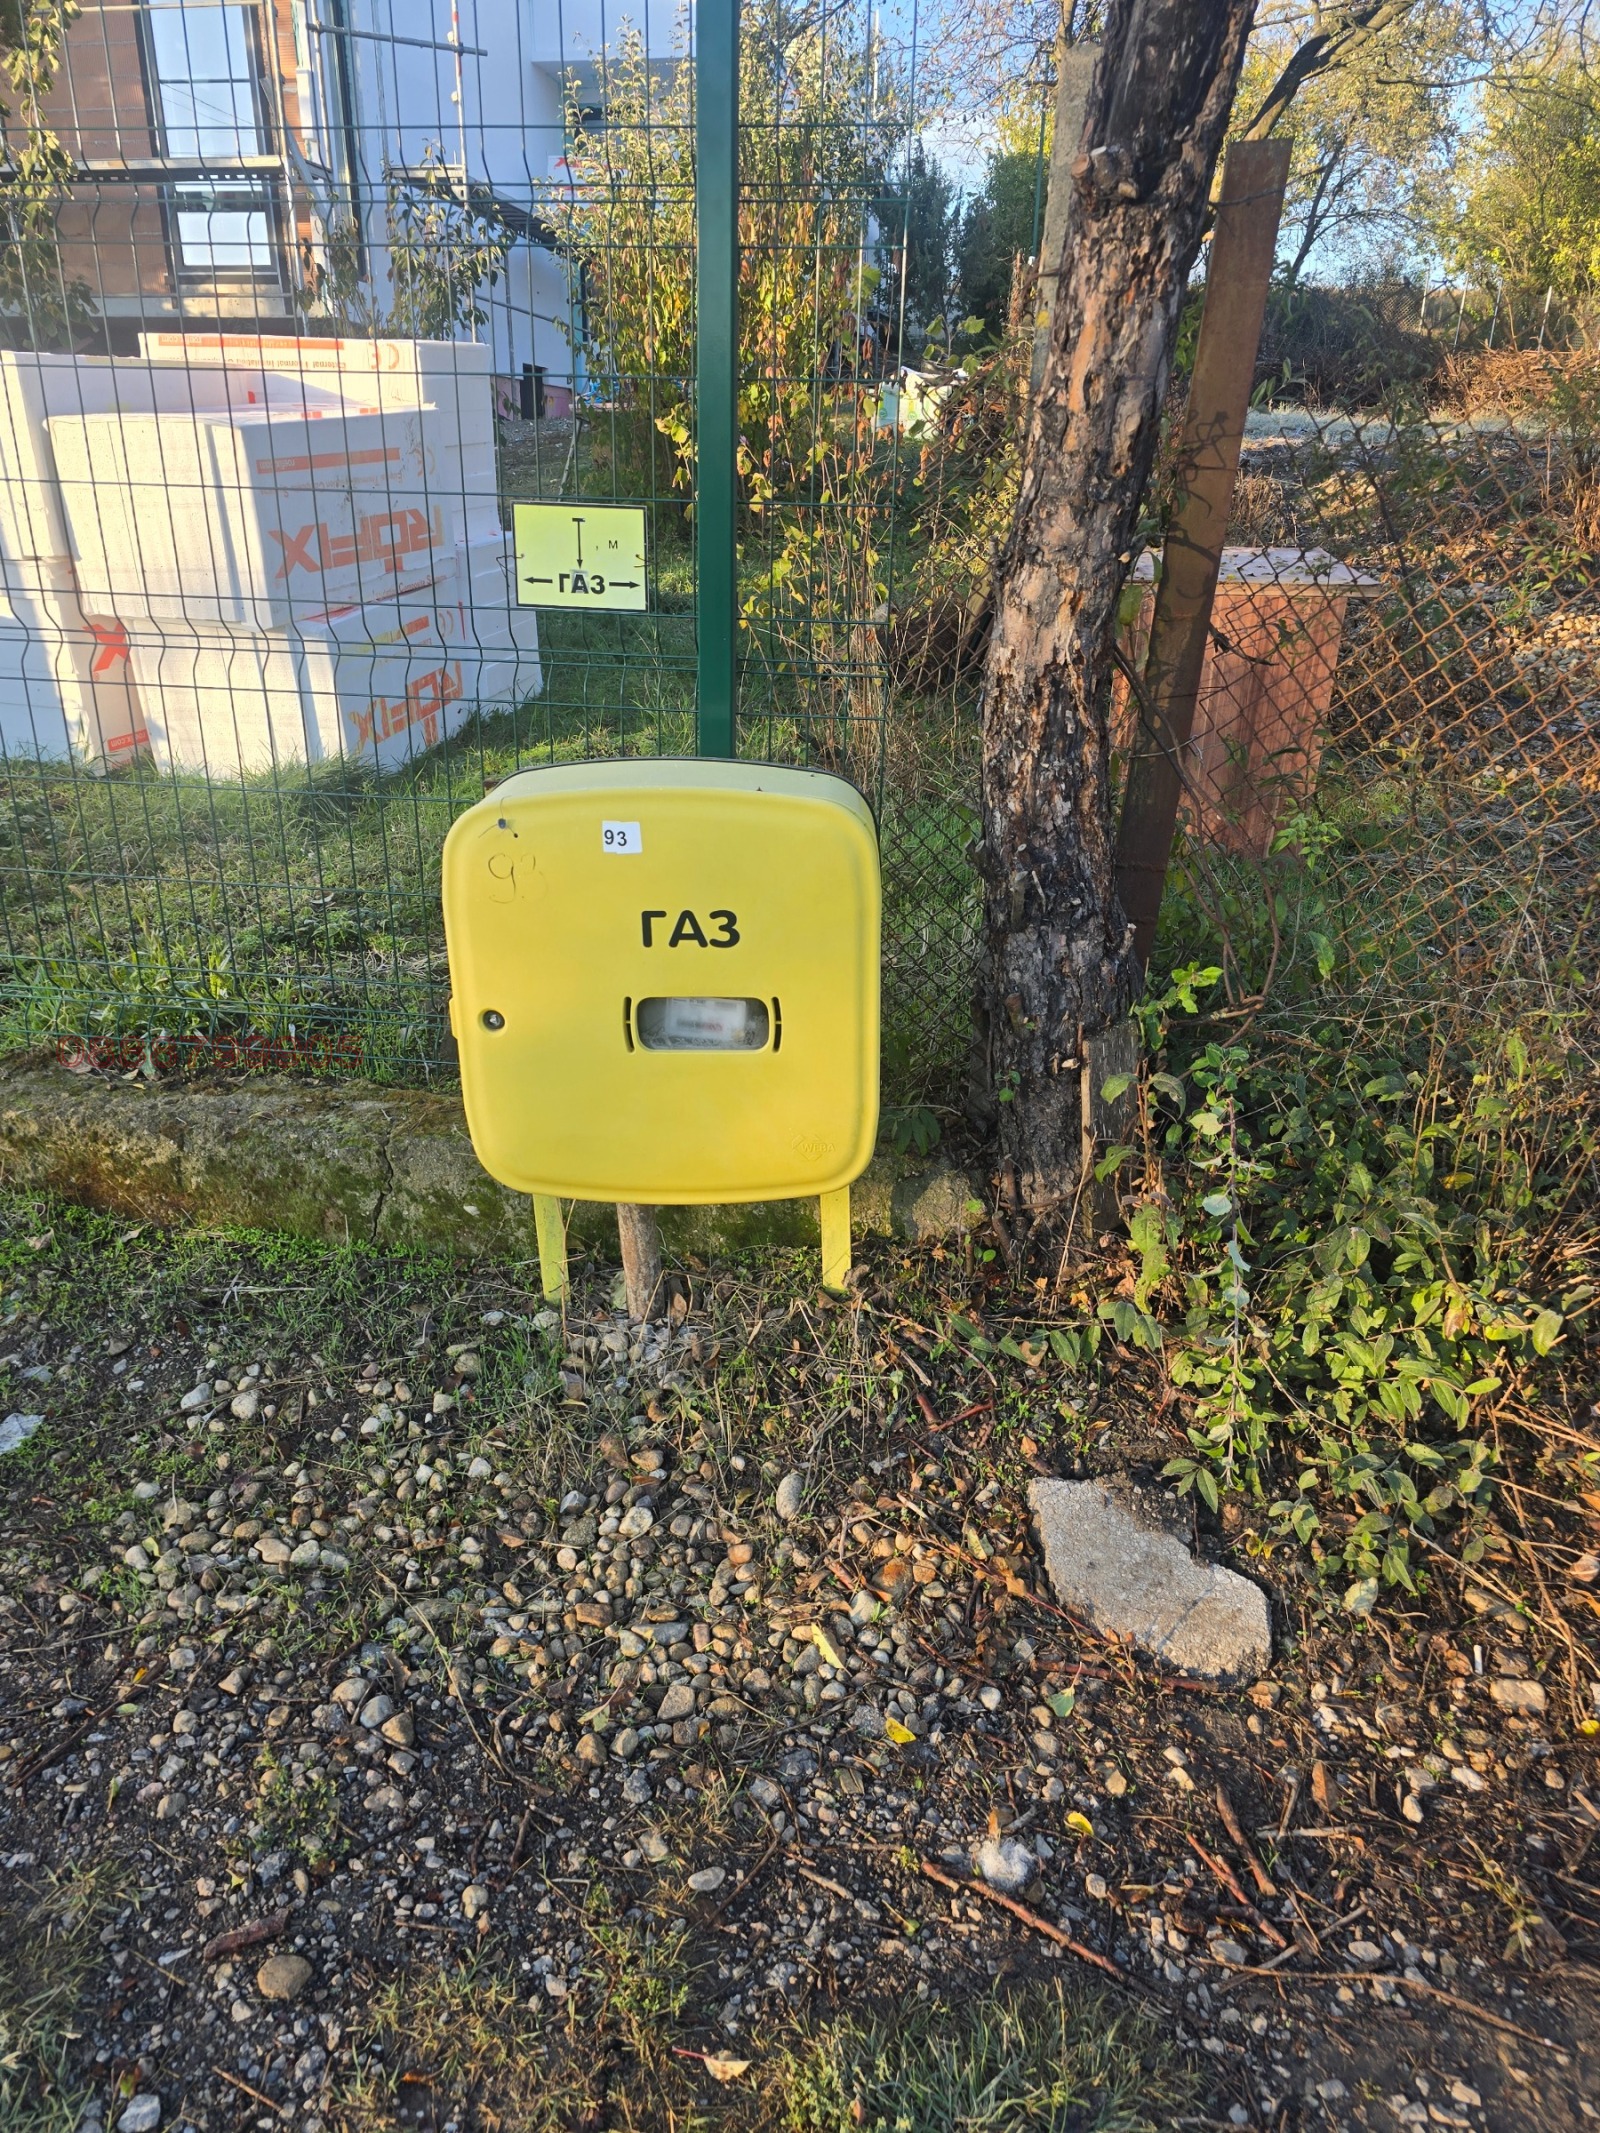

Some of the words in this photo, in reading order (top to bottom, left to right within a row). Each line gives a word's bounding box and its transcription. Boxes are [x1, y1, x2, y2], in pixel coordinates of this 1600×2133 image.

[312, 361, 347, 372] Eternal
[558, 572, 606, 595] ГАЗ
[604, 829, 628, 847] 93
[641, 909, 740, 949] ГАЗ
